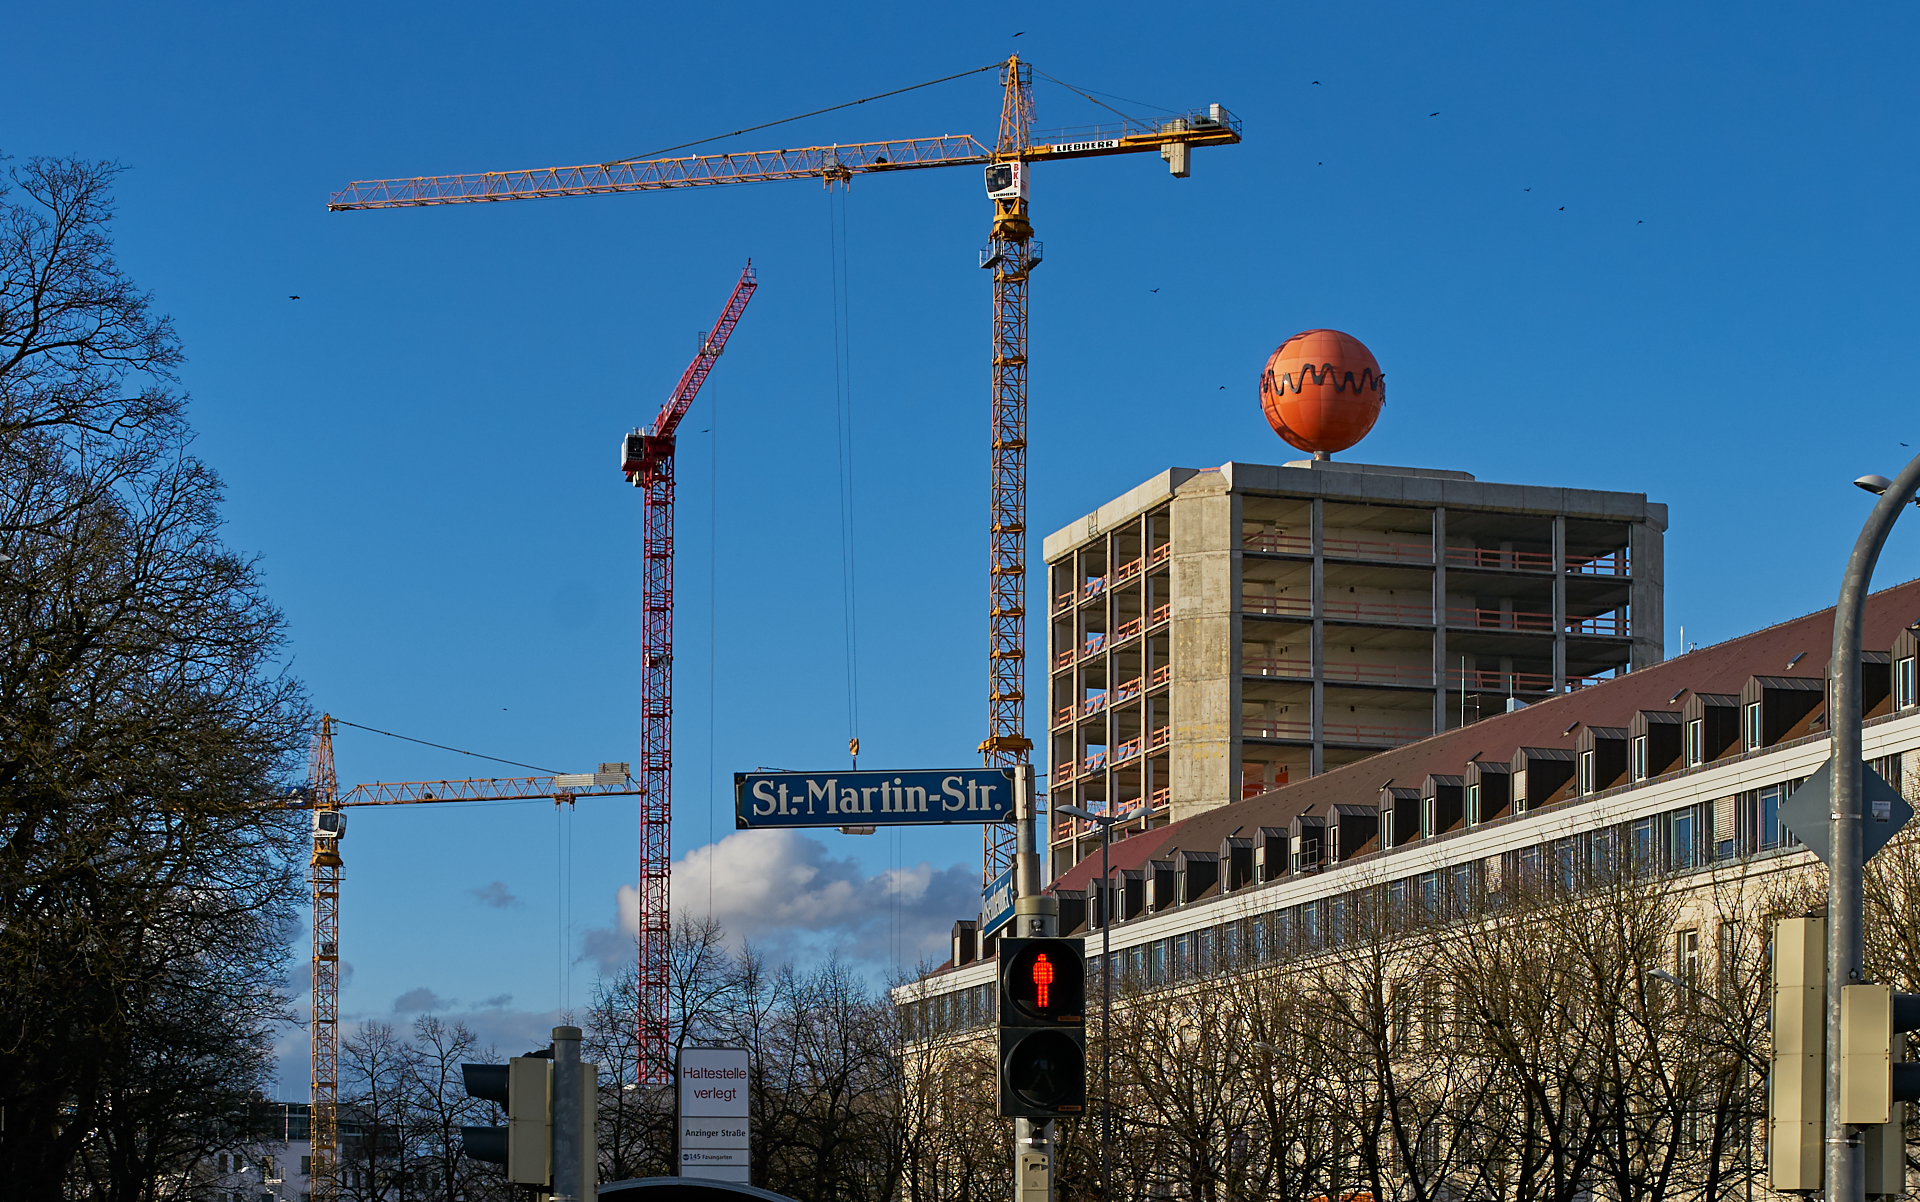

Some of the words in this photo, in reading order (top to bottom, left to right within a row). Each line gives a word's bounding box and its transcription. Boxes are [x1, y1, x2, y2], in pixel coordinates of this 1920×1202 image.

[1056, 140, 1113, 151] LIEBHERR
[752, 775, 1002, 816] St.-Martin-Str.
[683, 1067, 747, 1079] Haltestelle
[694, 1087, 737, 1102] verlegt
[685, 1129, 719, 1139] Anzinger
[721, 1129, 746, 1137] Straße
